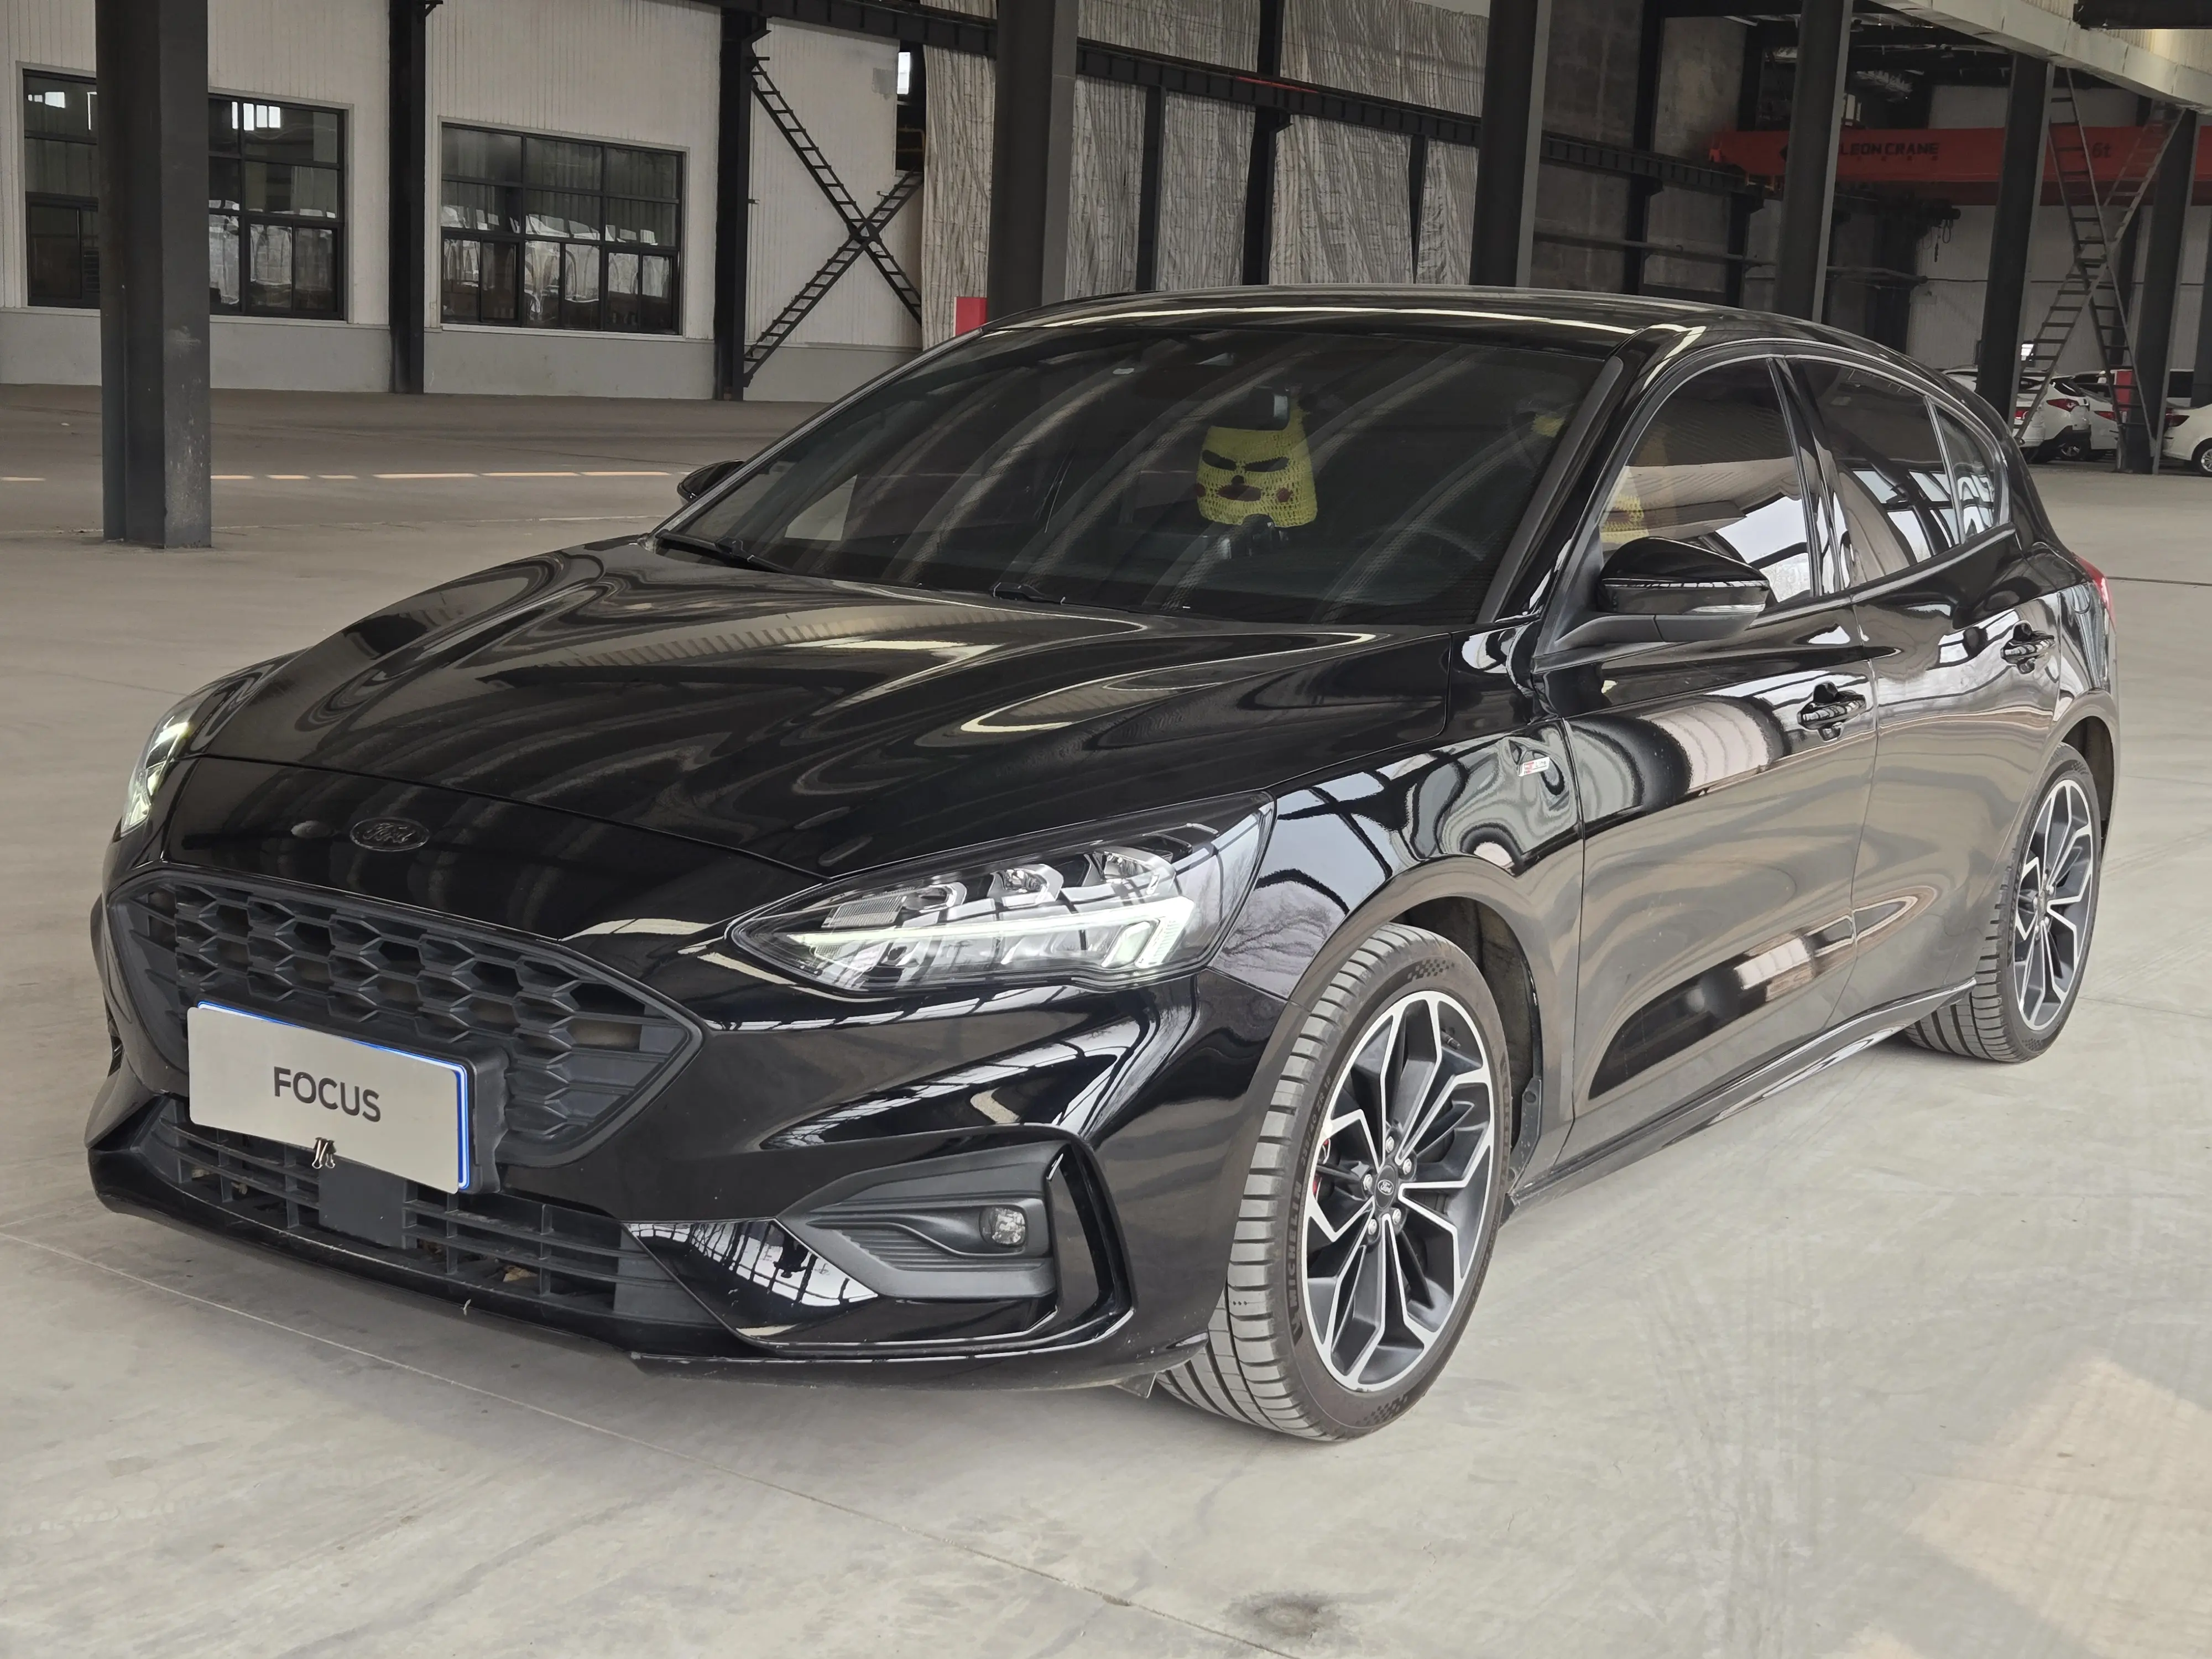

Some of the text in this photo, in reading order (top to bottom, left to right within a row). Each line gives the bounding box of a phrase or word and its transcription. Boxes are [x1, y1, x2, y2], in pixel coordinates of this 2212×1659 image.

[1885, 142, 1939, 155] CRANE
[363, 822, 416, 843] Ford
[274, 1066, 382, 1122] FOCUS
[1316, 1093, 1324, 1112] ZR
[1288, 1181, 1302, 1308] MICHELIN
